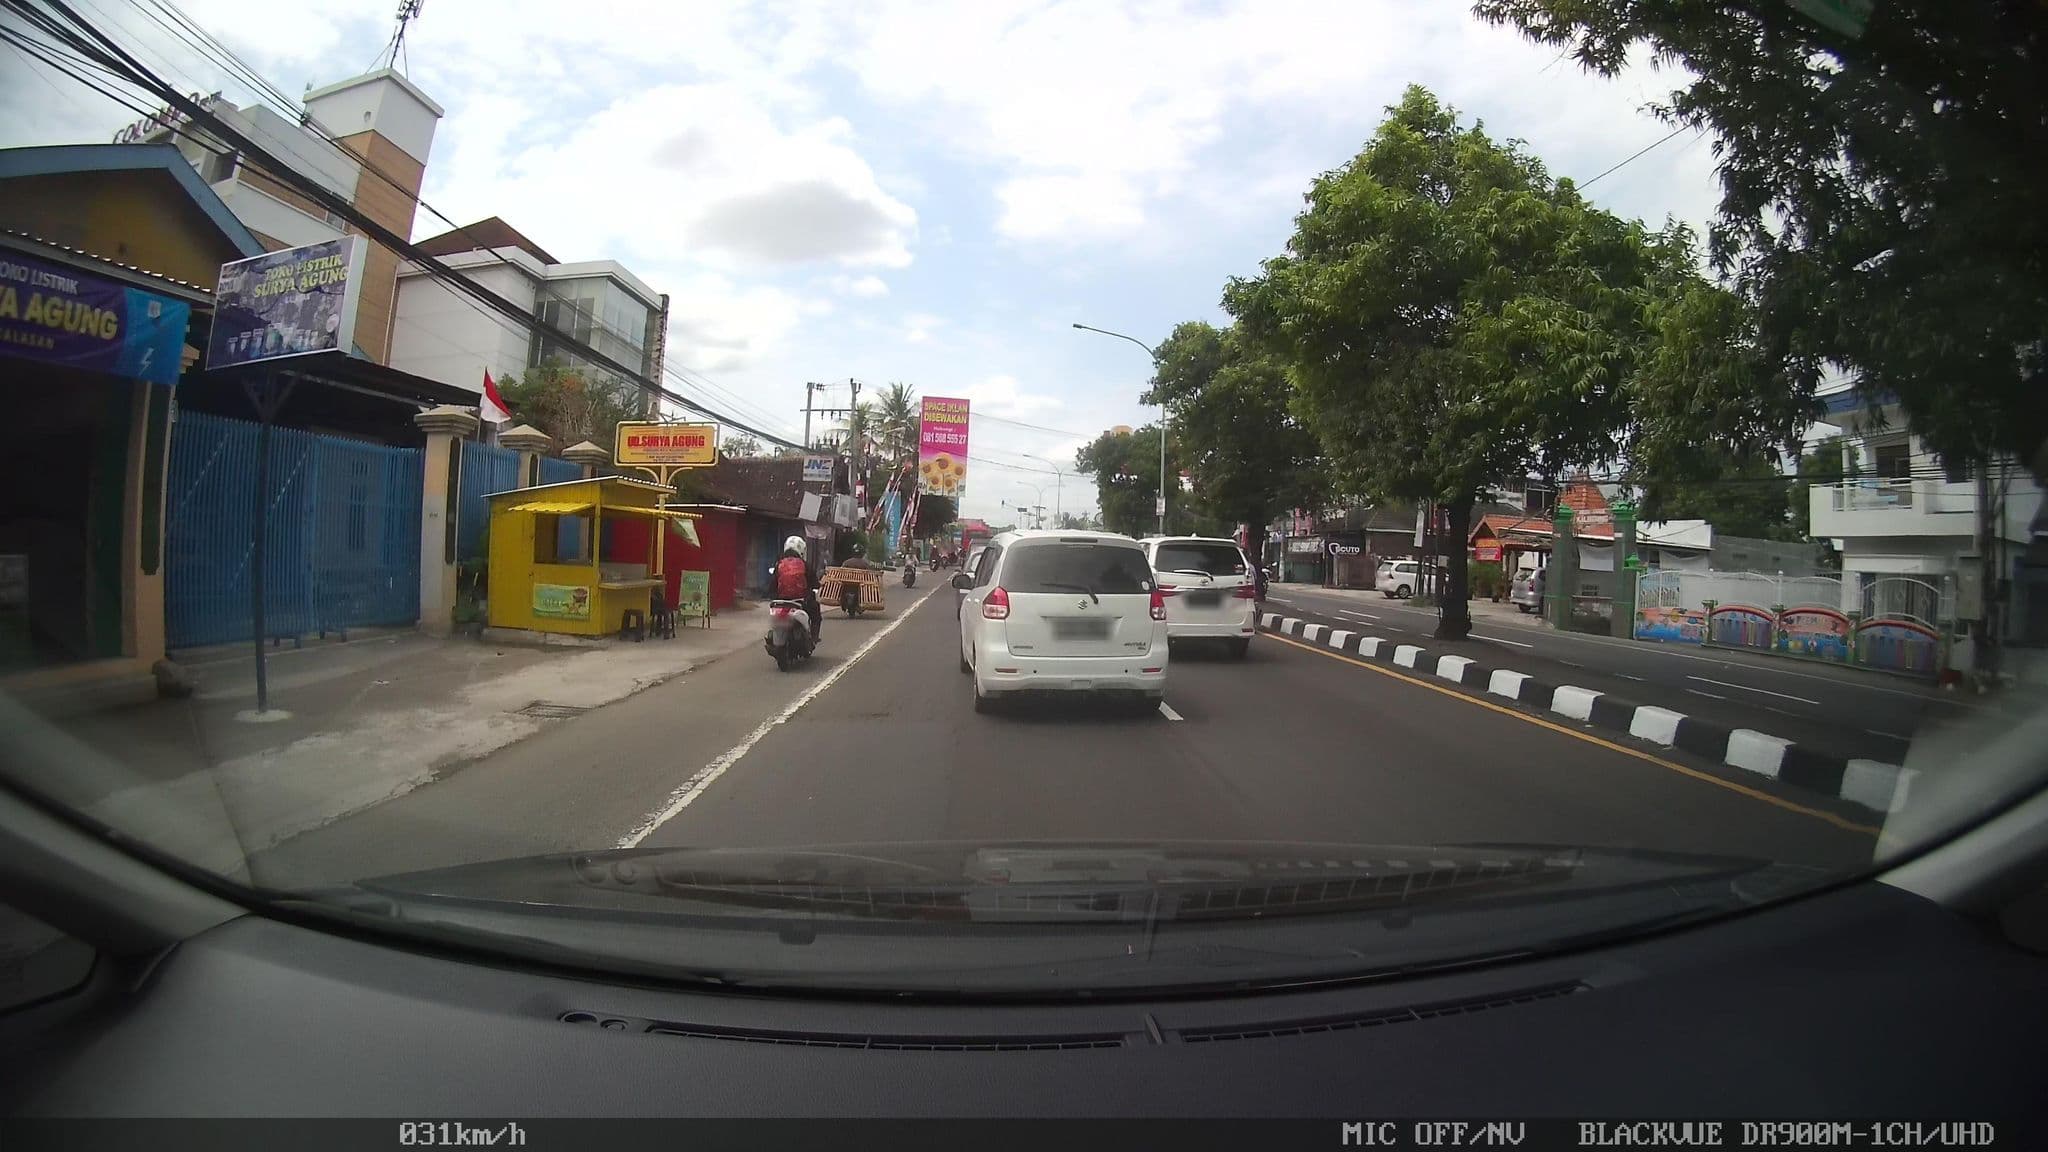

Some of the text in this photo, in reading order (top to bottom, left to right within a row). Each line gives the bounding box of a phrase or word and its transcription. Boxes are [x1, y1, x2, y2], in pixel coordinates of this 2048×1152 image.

[264, 254, 343, 281] TOKO LISTRIK
[31, 268, 79, 295] LISTRIK
[254, 277, 296, 297] SURYA
[299, 266, 349, 289] AGUNG
[24, 291, 118, 341] AGUNG
[671, 435, 705, 447] AGUNG
